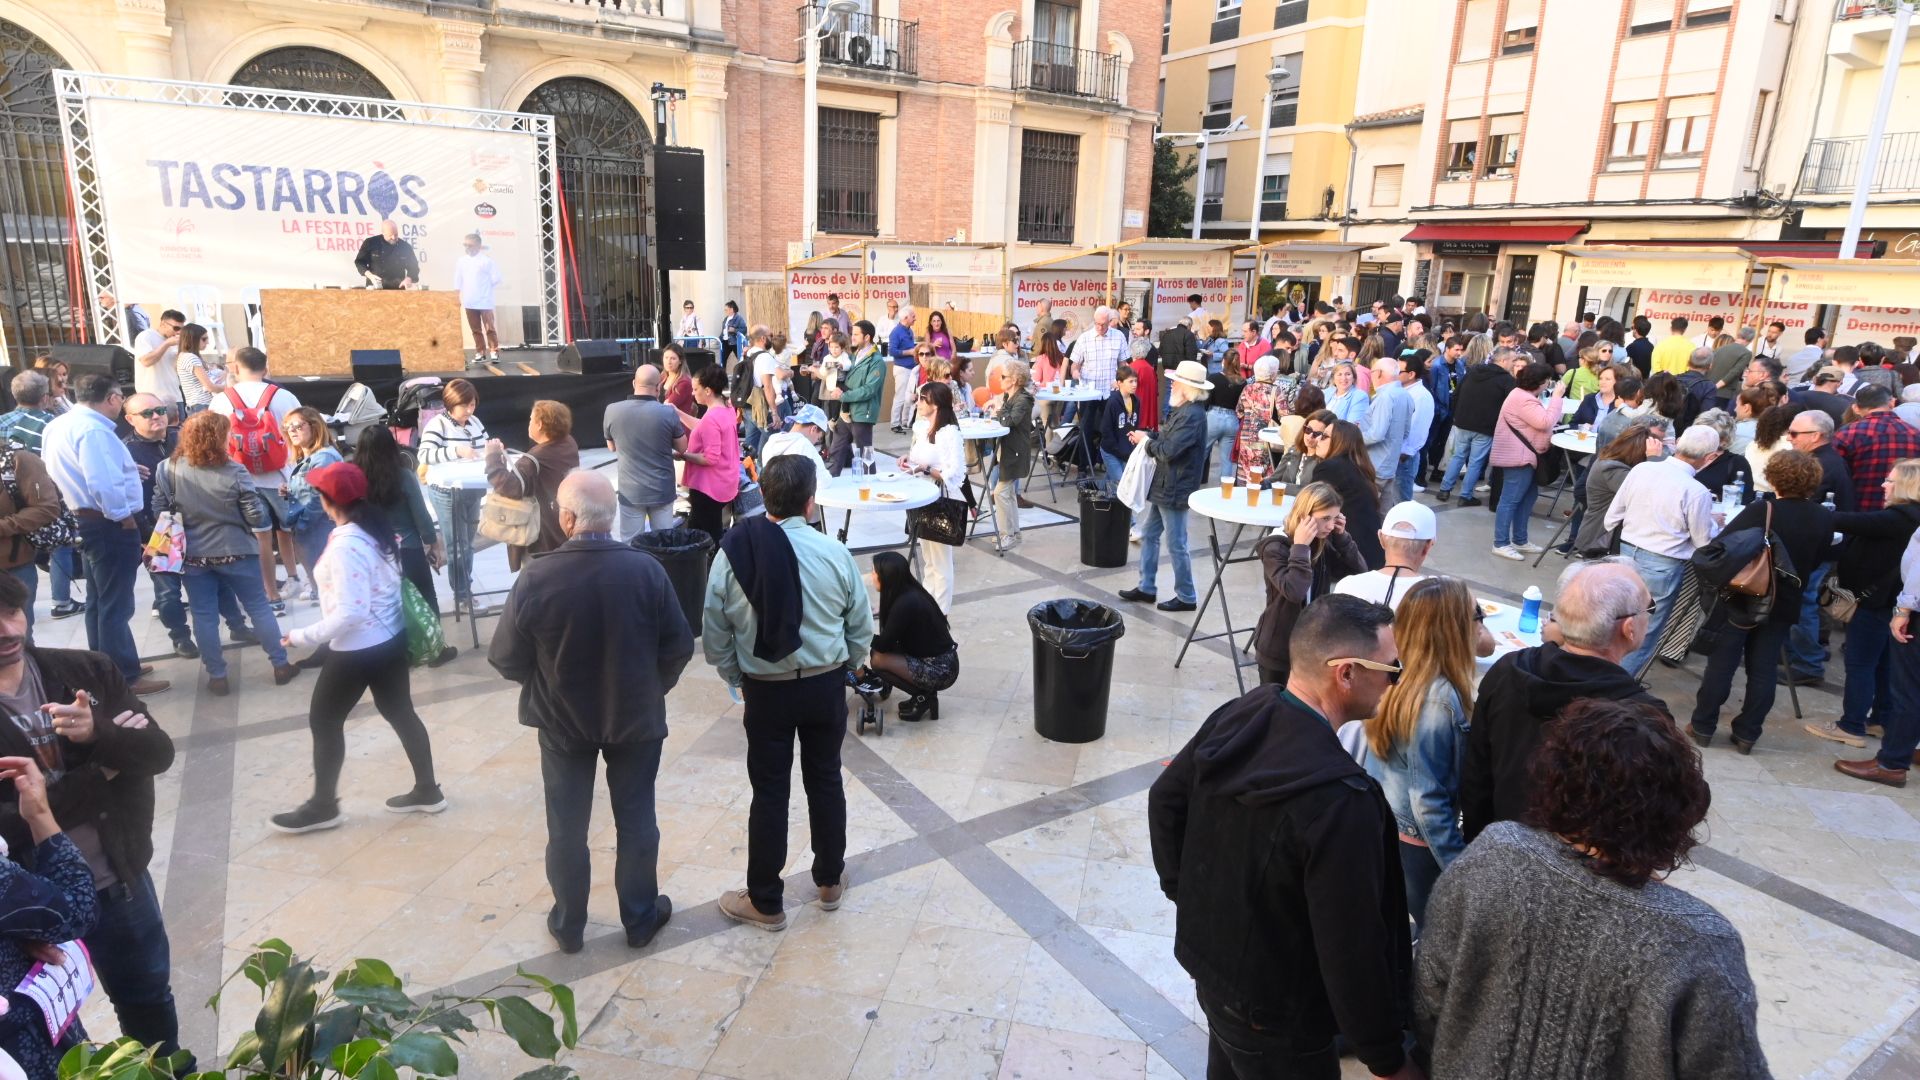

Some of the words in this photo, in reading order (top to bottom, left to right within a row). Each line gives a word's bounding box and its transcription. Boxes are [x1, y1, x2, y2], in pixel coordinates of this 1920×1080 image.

[282, 219, 301, 234] LA
[305, 220, 352, 236] FESTA
[356, 222, 375, 237] DE
[316, 236, 365, 252] L'ARRÒ
[791, 273, 826, 285] Arròs
[831, 273, 846, 285] de
[1018, 279, 1049, 292] Arròs
[1053, 280, 1066, 291] de
[1187, 278, 1198, 288] de
[1648, 291, 1693, 305] Arròs
[1698, 293, 1721, 306] de
